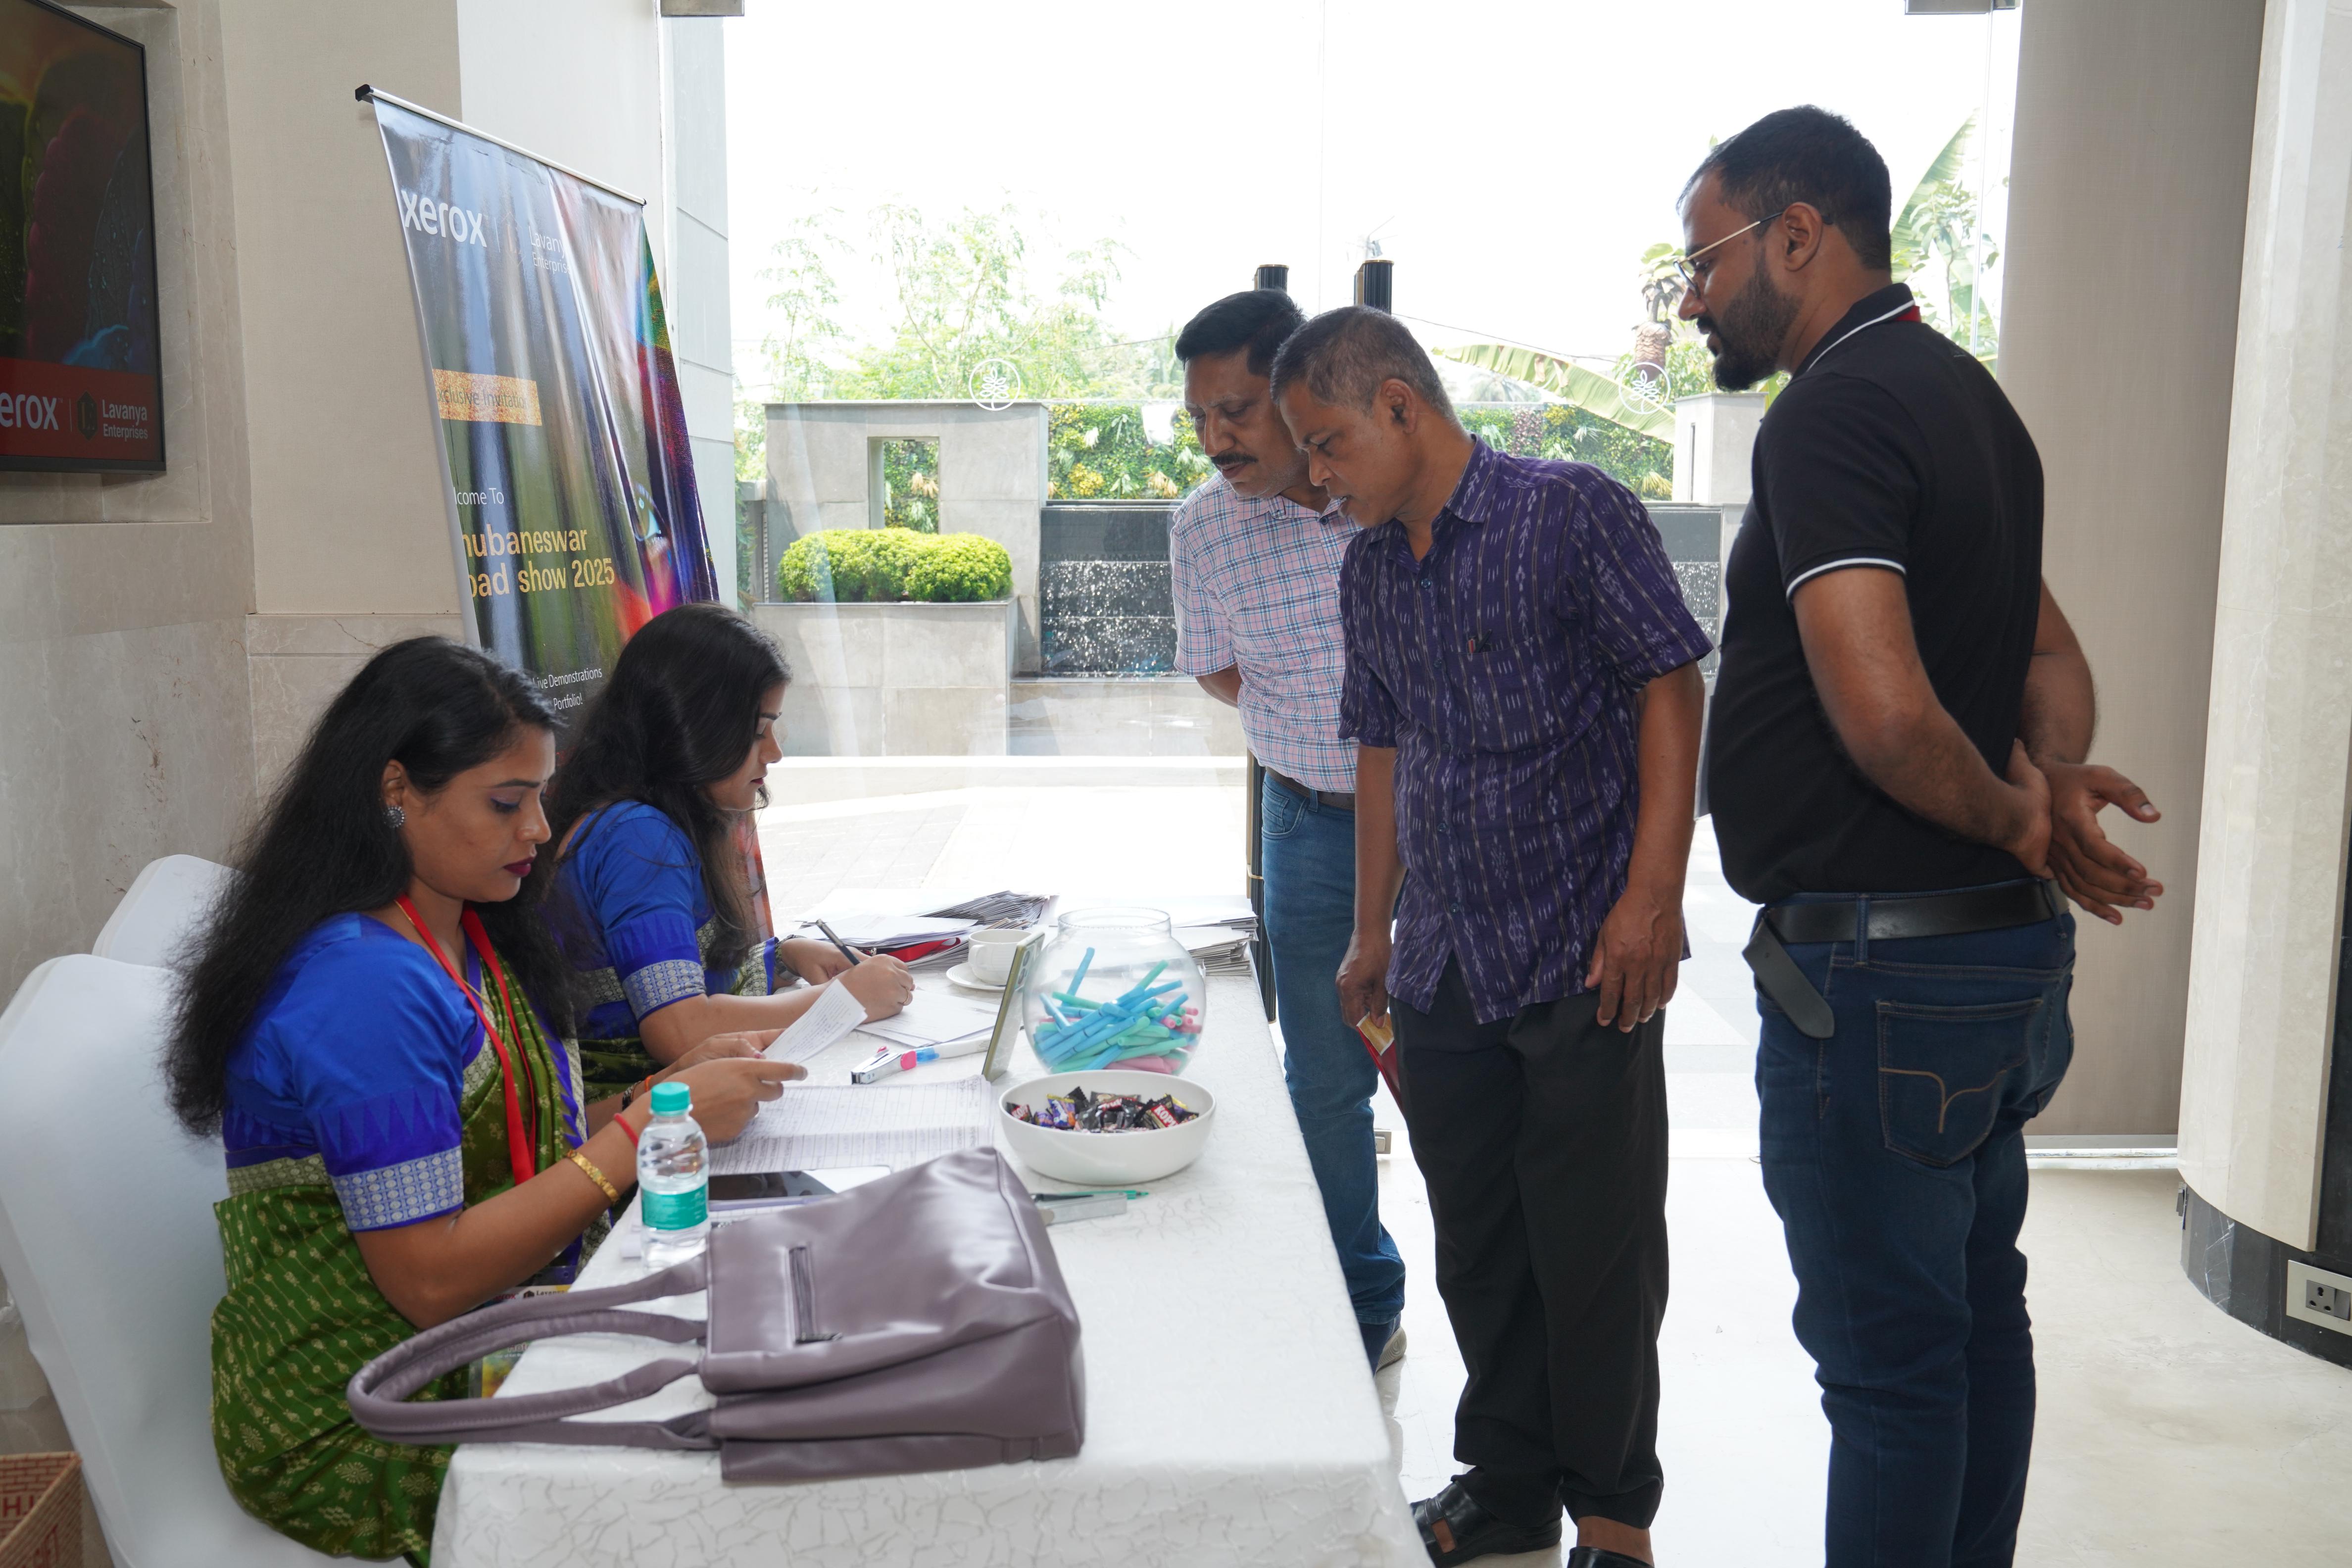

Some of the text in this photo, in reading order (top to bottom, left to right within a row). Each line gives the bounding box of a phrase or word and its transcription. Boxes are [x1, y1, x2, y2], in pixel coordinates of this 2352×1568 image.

[401, 191, 487, 247] xerox
[528, 226, 565, 258] Lavany
[102, 399, 147, 426] Lavanya
[103, 423, 148, 441] Enterprises
[489, 488, 504, 505] To
[518, 560, 567, 593] show
[572, 558, 615, 588] 2025
[548, 668, 602, 688] Demonstrations
[553, 692, 583, 711] Portfolio!
